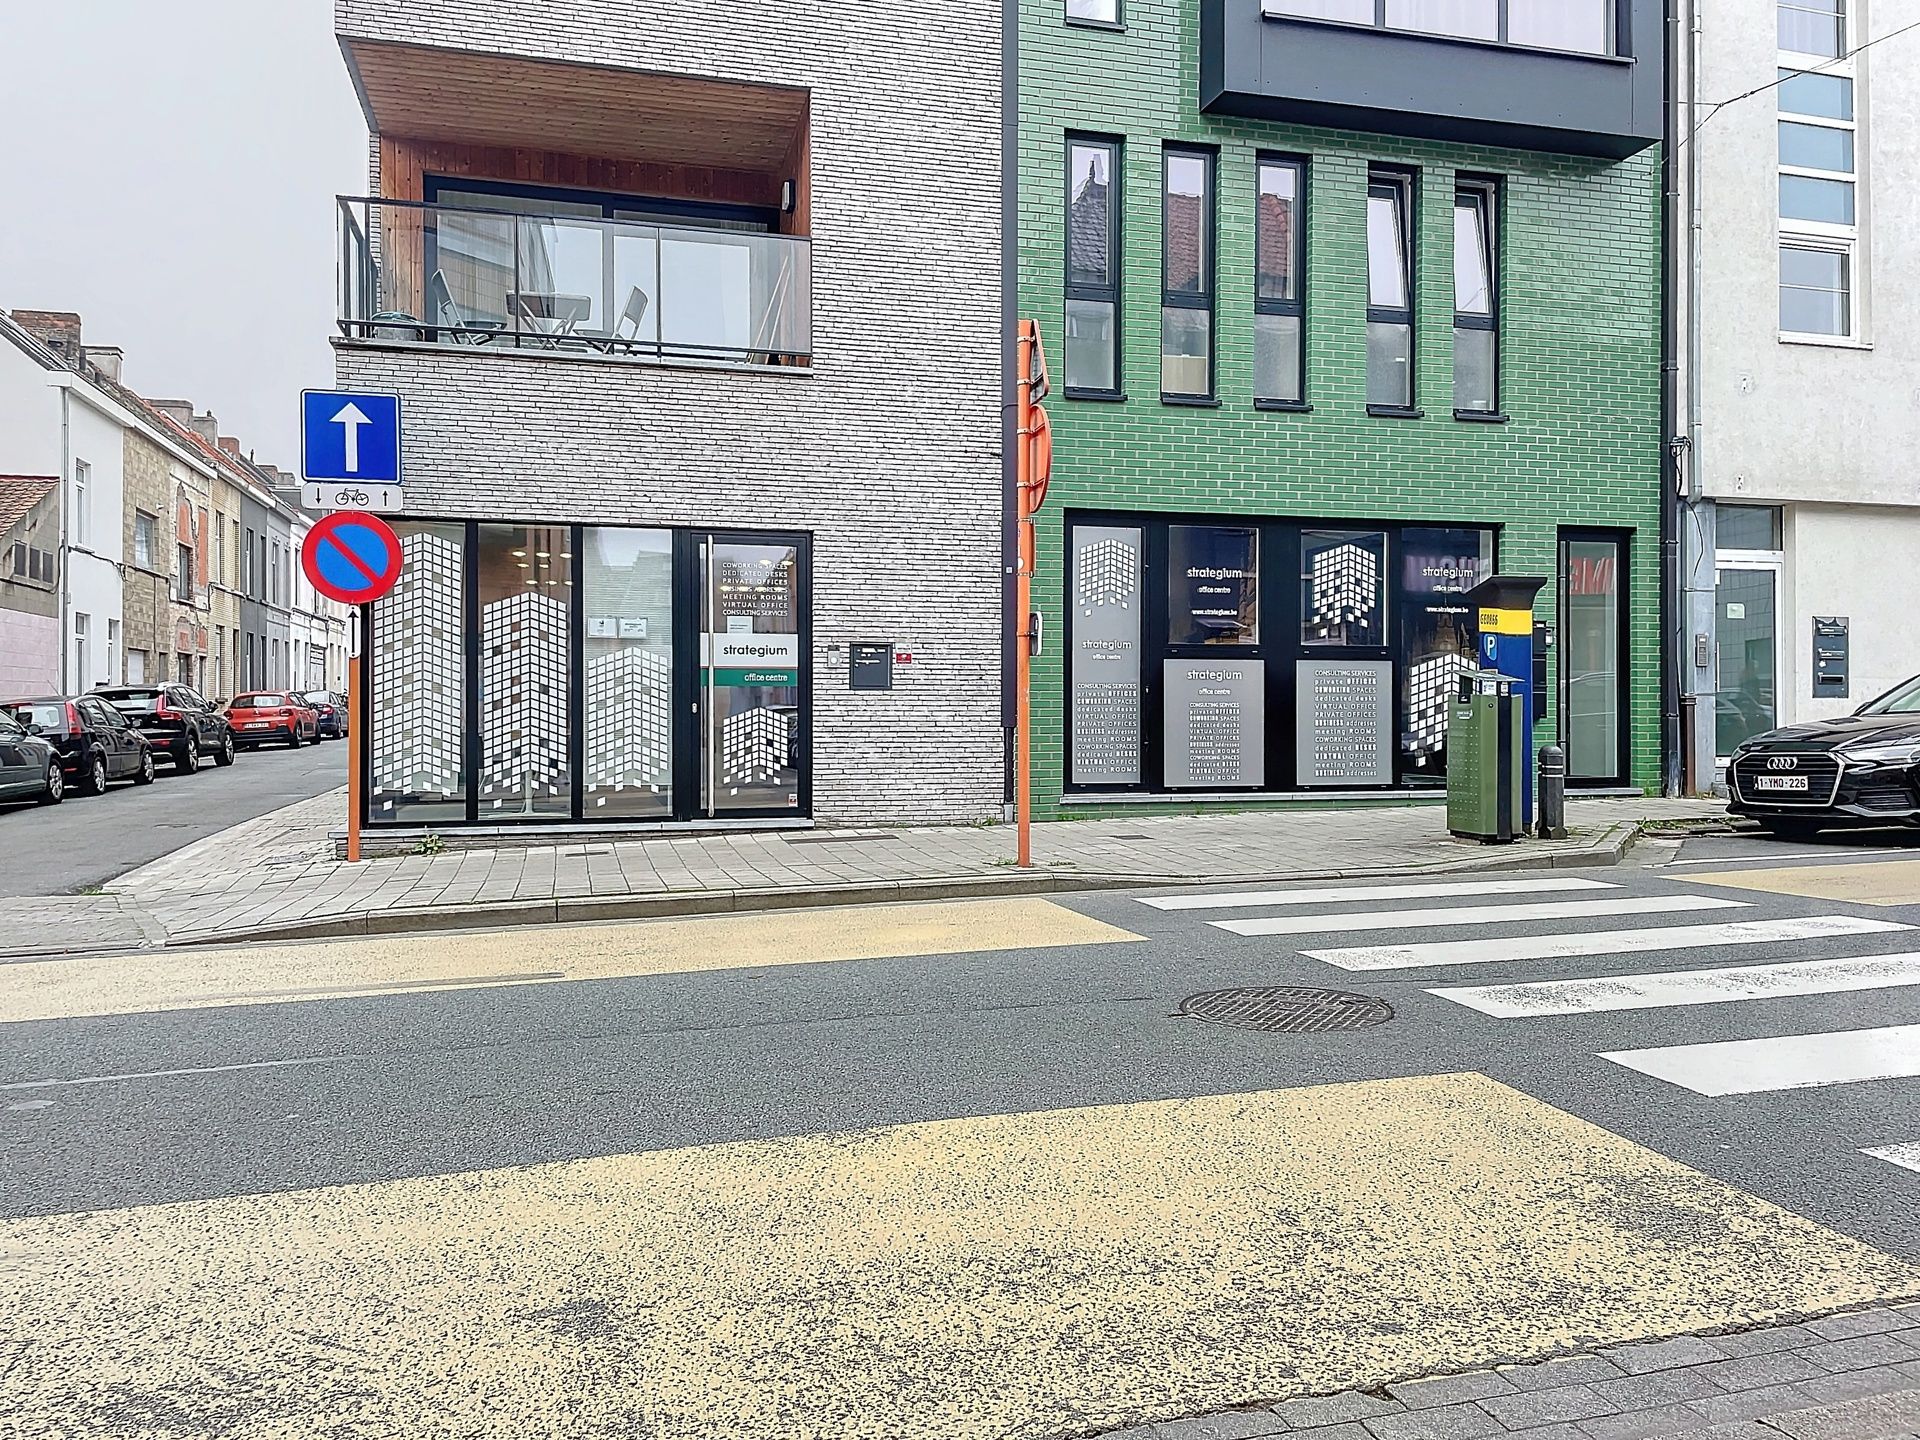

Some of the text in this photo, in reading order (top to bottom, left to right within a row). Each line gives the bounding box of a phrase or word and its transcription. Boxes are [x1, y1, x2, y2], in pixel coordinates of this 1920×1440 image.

[1187, 567, 1242, 579] strategium
[1422, 566, 1473, 579] strategium
[723, 645, 787, 657] strategium
[1083, 640, 1131, 650] strategium
[1487, 636, 1495, 656] P
[1187, 670, 1242, 681] strategium
